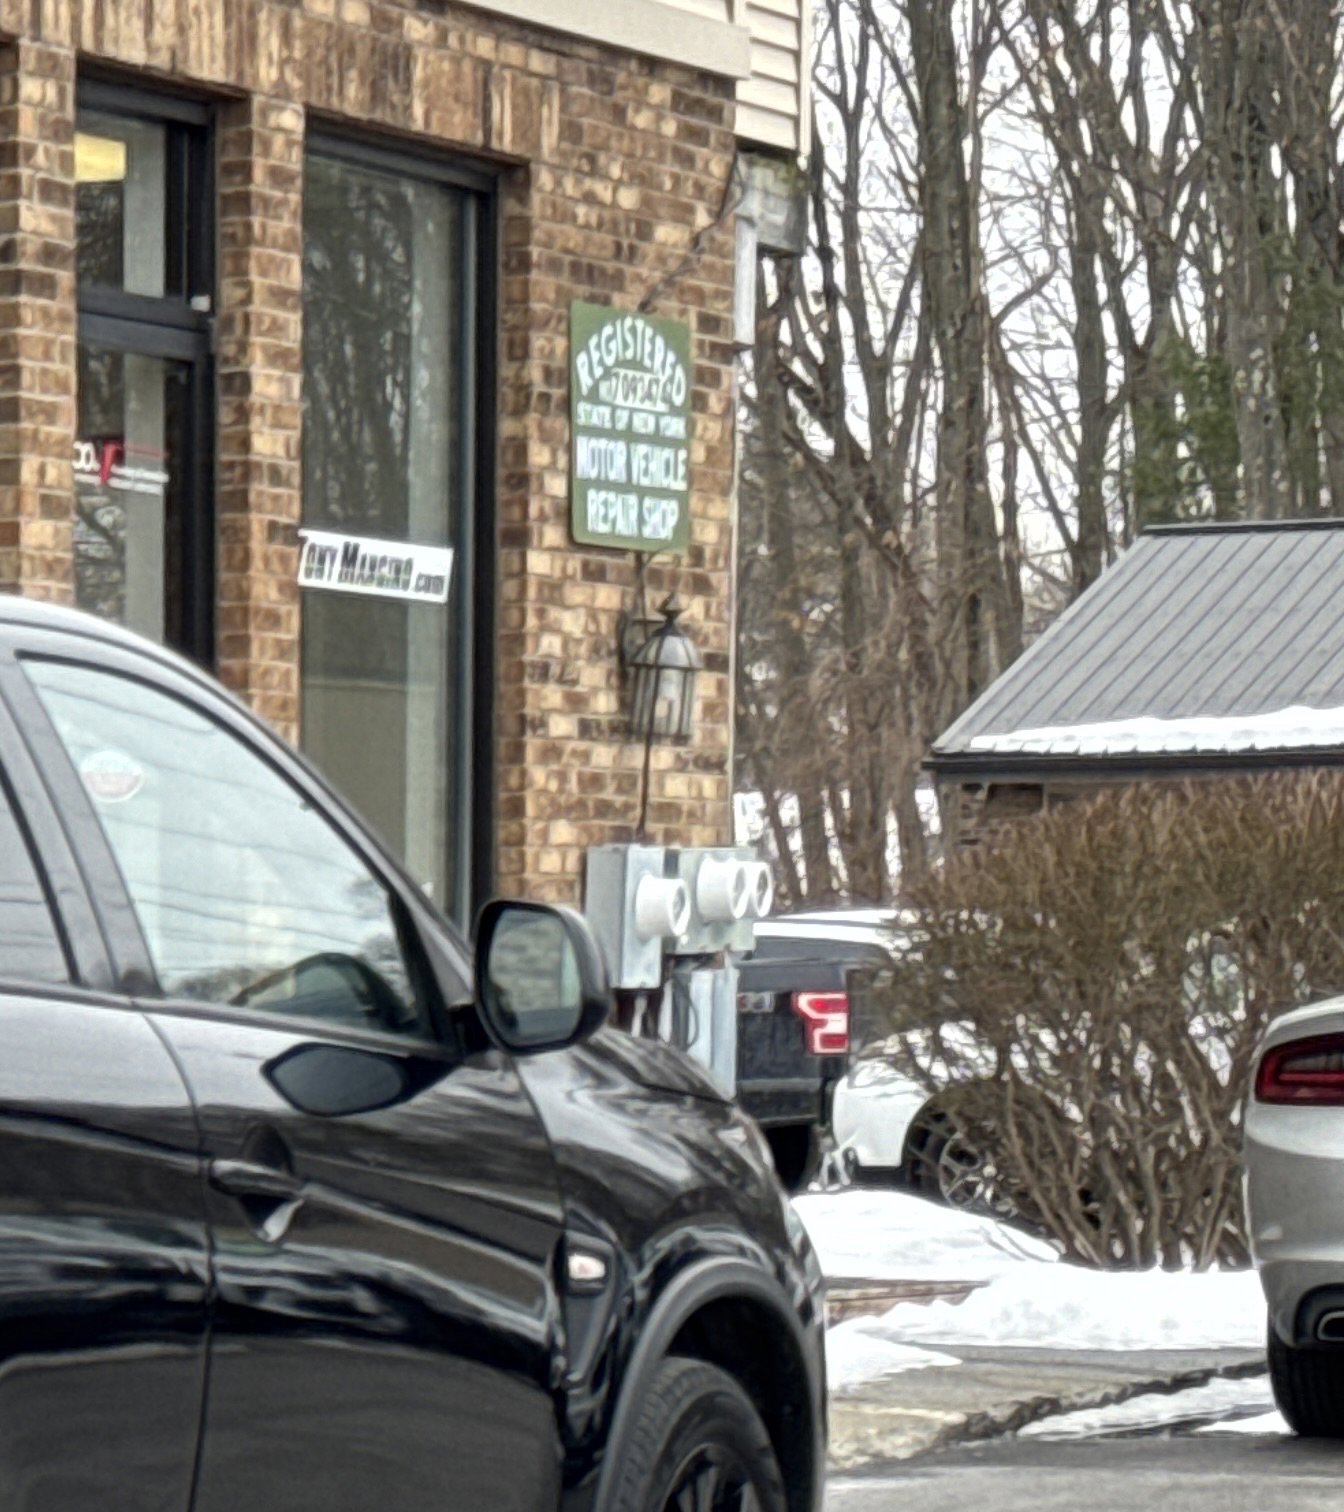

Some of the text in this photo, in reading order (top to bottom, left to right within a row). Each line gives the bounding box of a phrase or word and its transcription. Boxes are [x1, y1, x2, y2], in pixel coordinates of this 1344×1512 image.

[575, 315, 687, 407] REGISTERED
[576, 435, 688, 492] MOTOR VEHICLE
[587, 488, 679, 541] REPAIR SHOP
